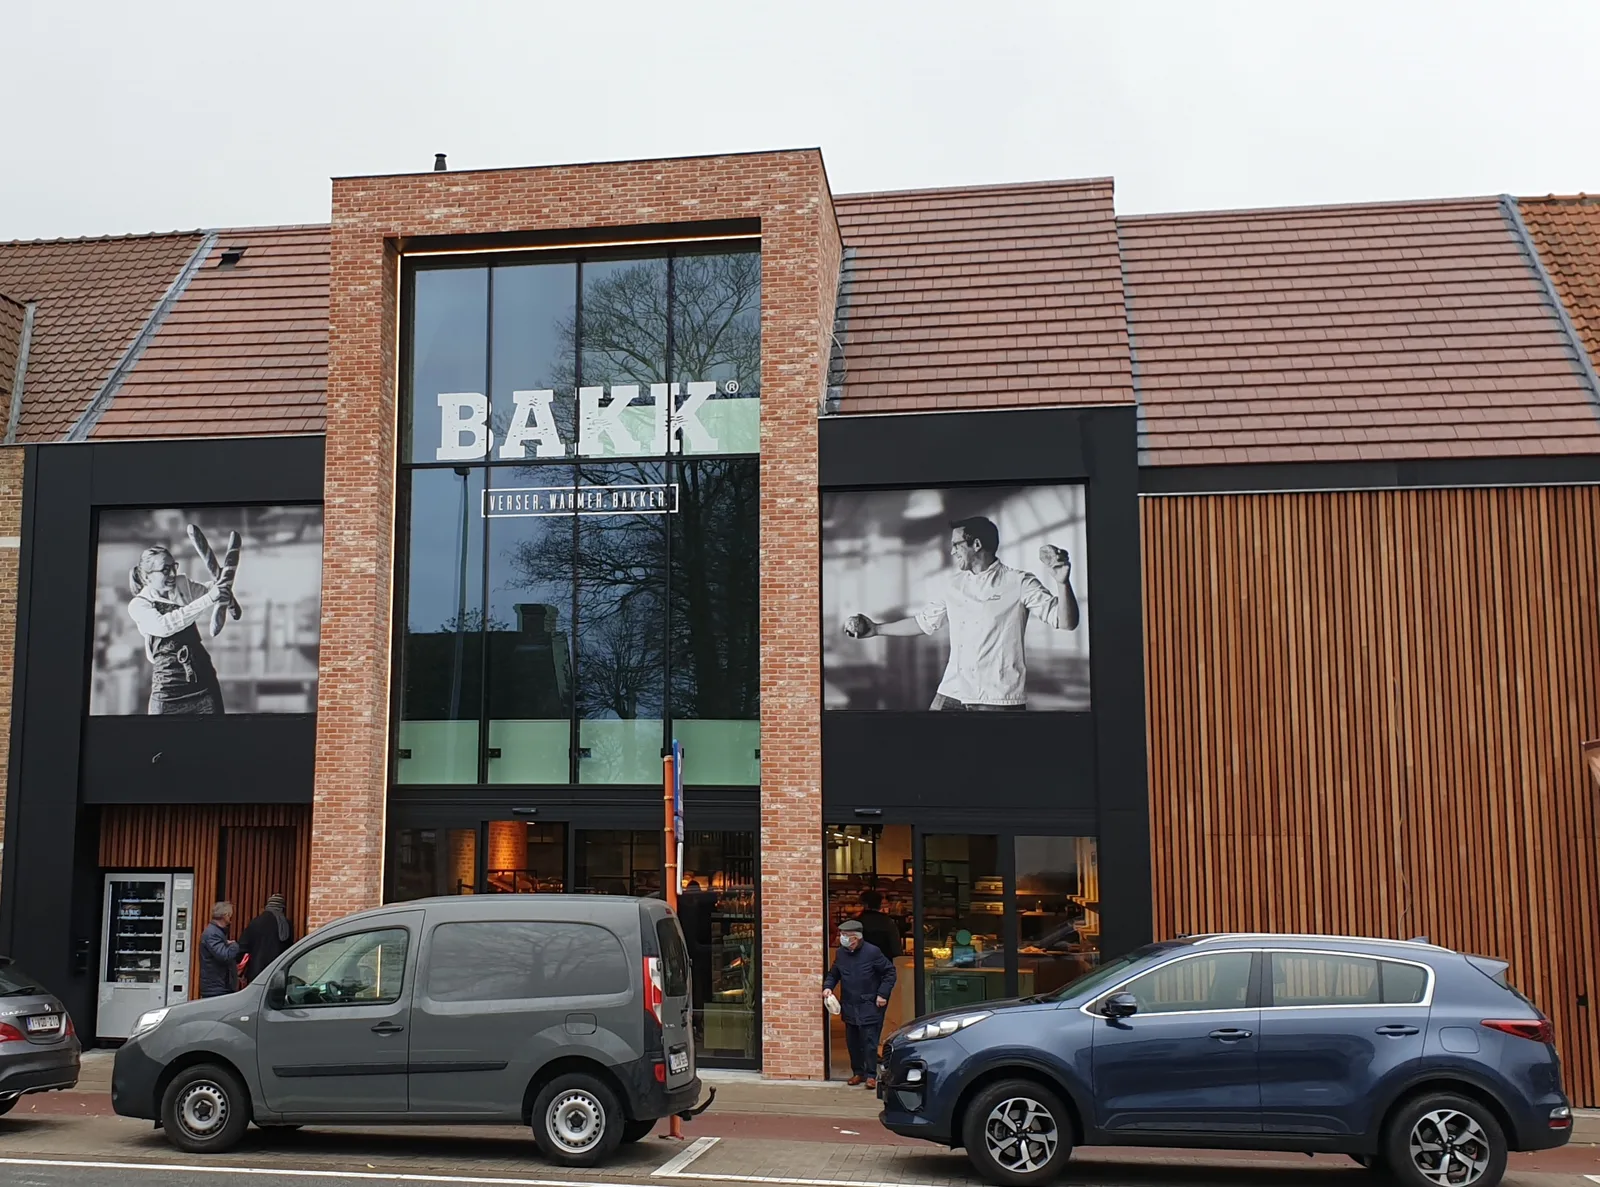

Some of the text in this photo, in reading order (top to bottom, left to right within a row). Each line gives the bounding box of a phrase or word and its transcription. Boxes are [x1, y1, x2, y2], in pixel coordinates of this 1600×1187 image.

[490, 490, 668, 511] VERSER. WARMER. BAKKER.
